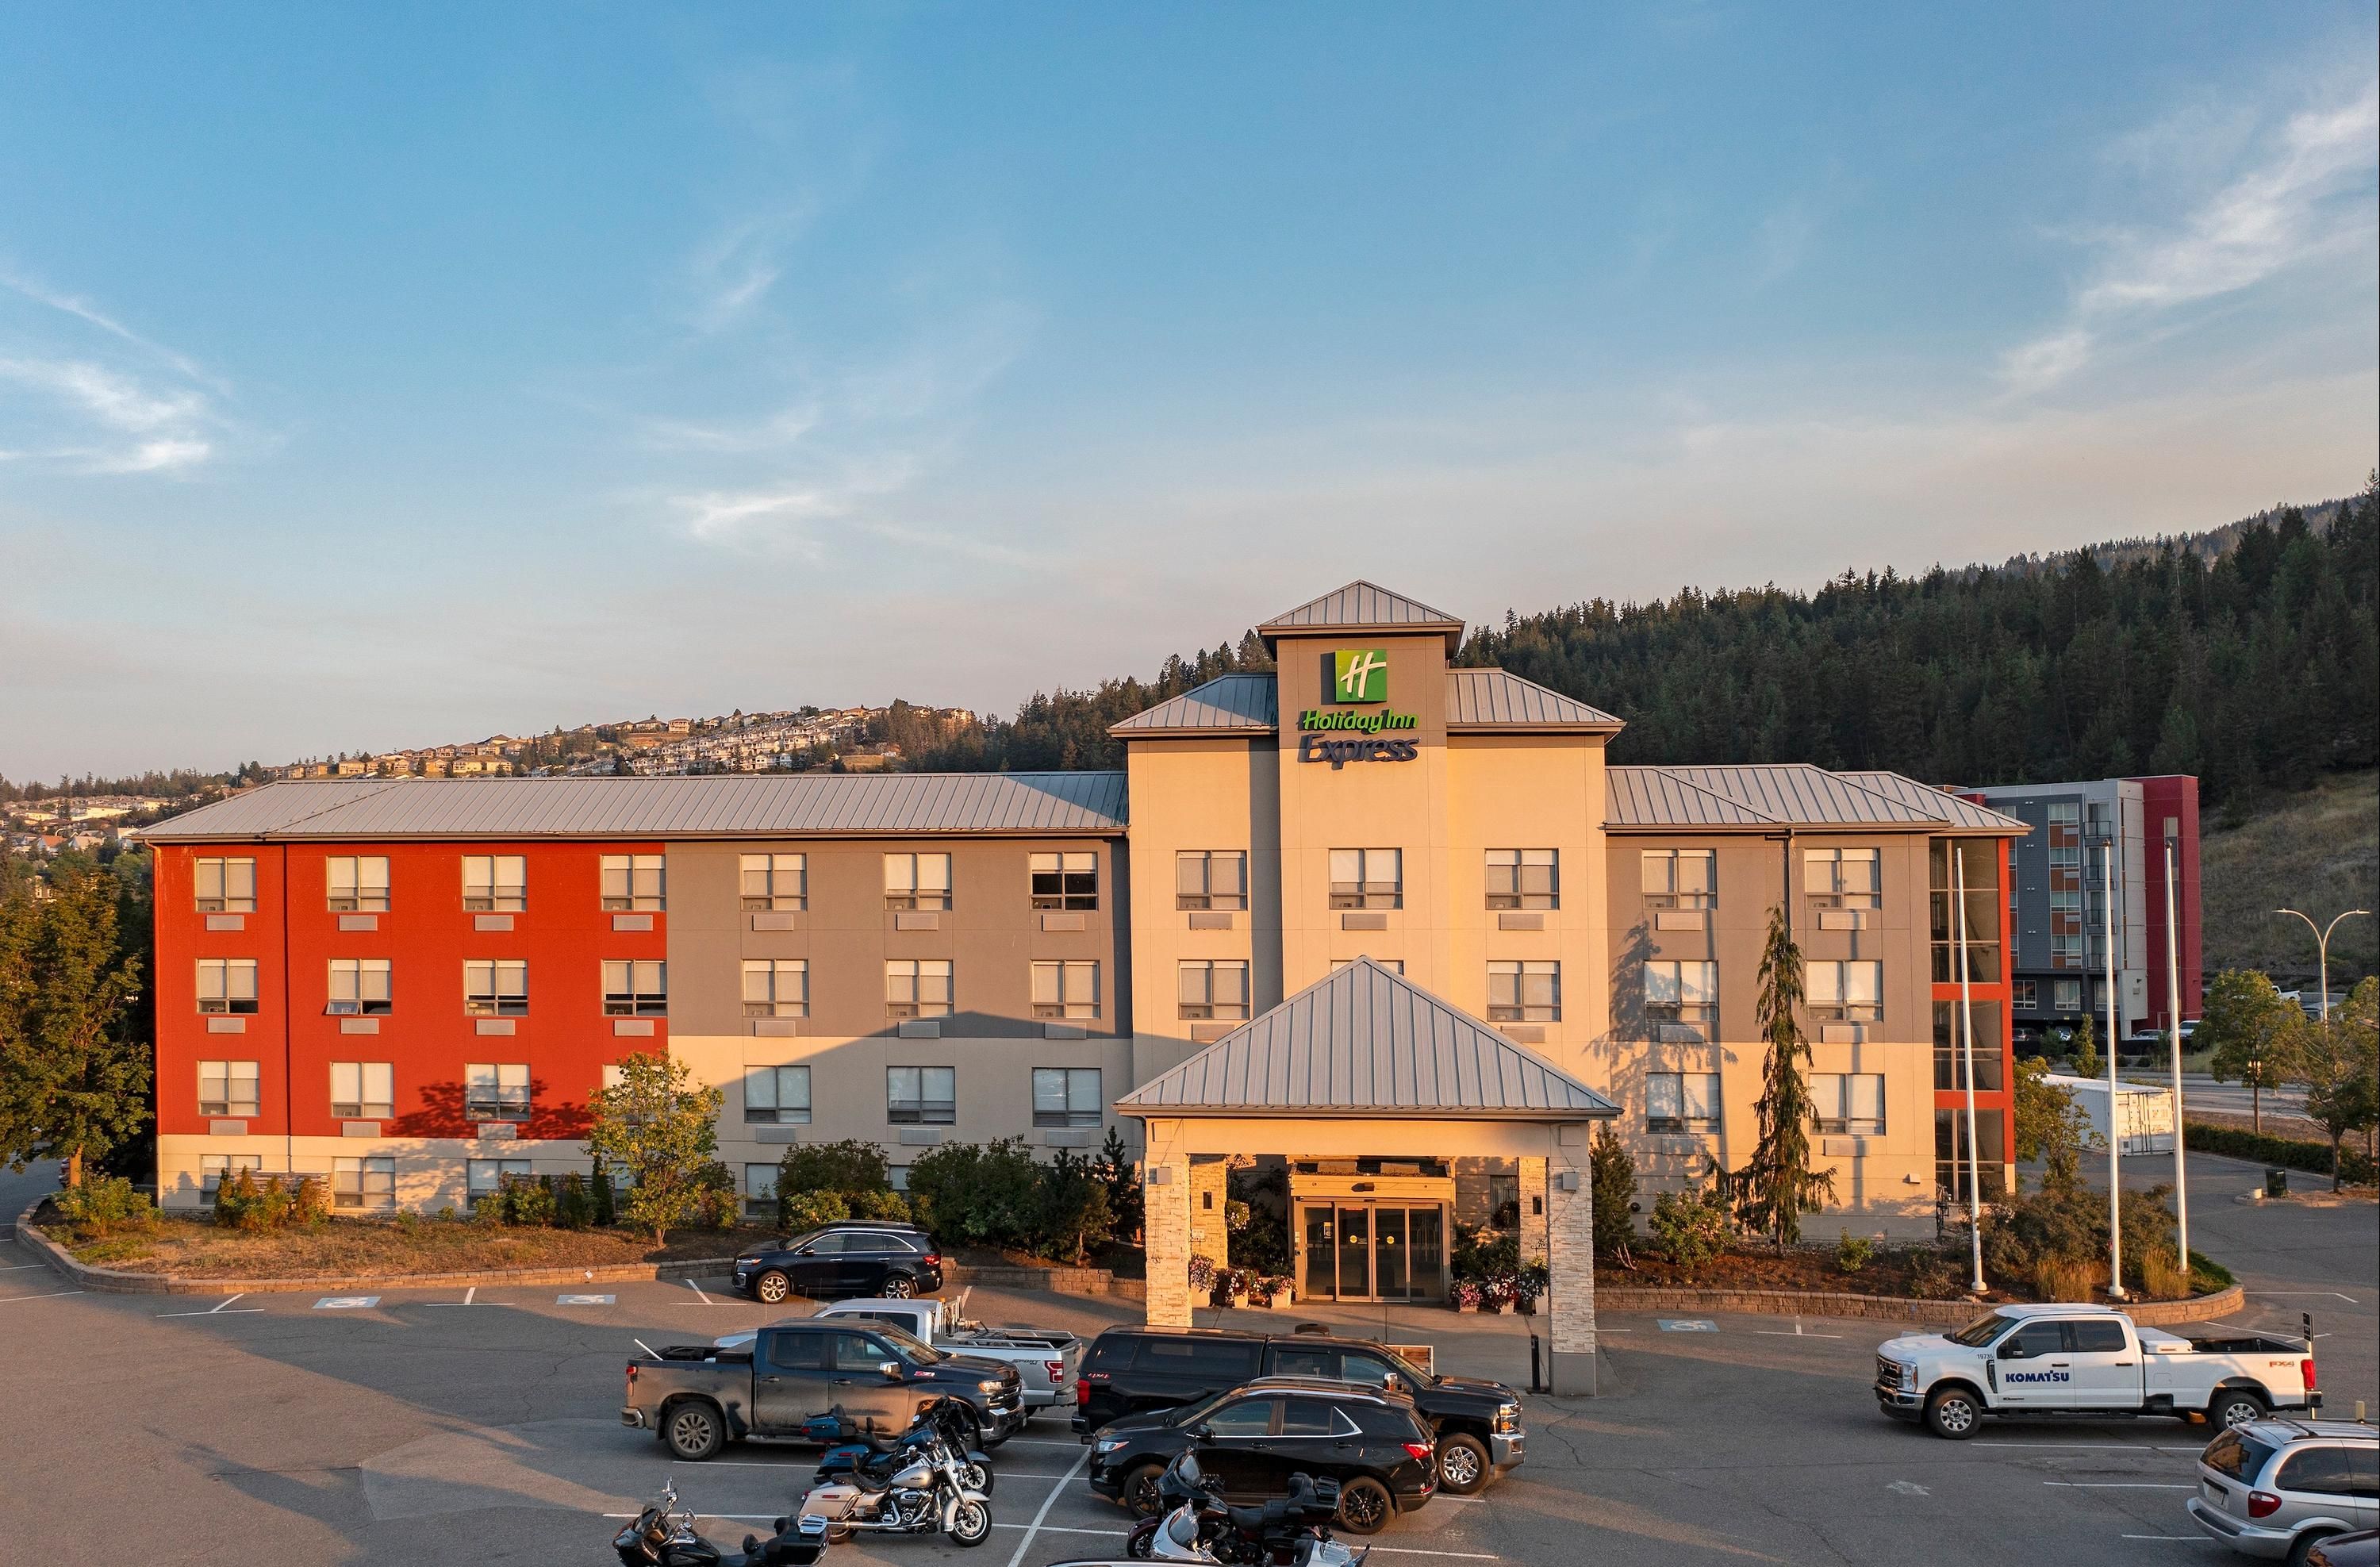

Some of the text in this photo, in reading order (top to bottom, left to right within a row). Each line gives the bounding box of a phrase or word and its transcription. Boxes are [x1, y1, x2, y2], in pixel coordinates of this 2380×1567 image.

[1303, 708, 1418, 734] Holiday Inn
[1304, 733, 1420, 770] Express
[2006, 1369, 2070, 1383] KOMATSU
